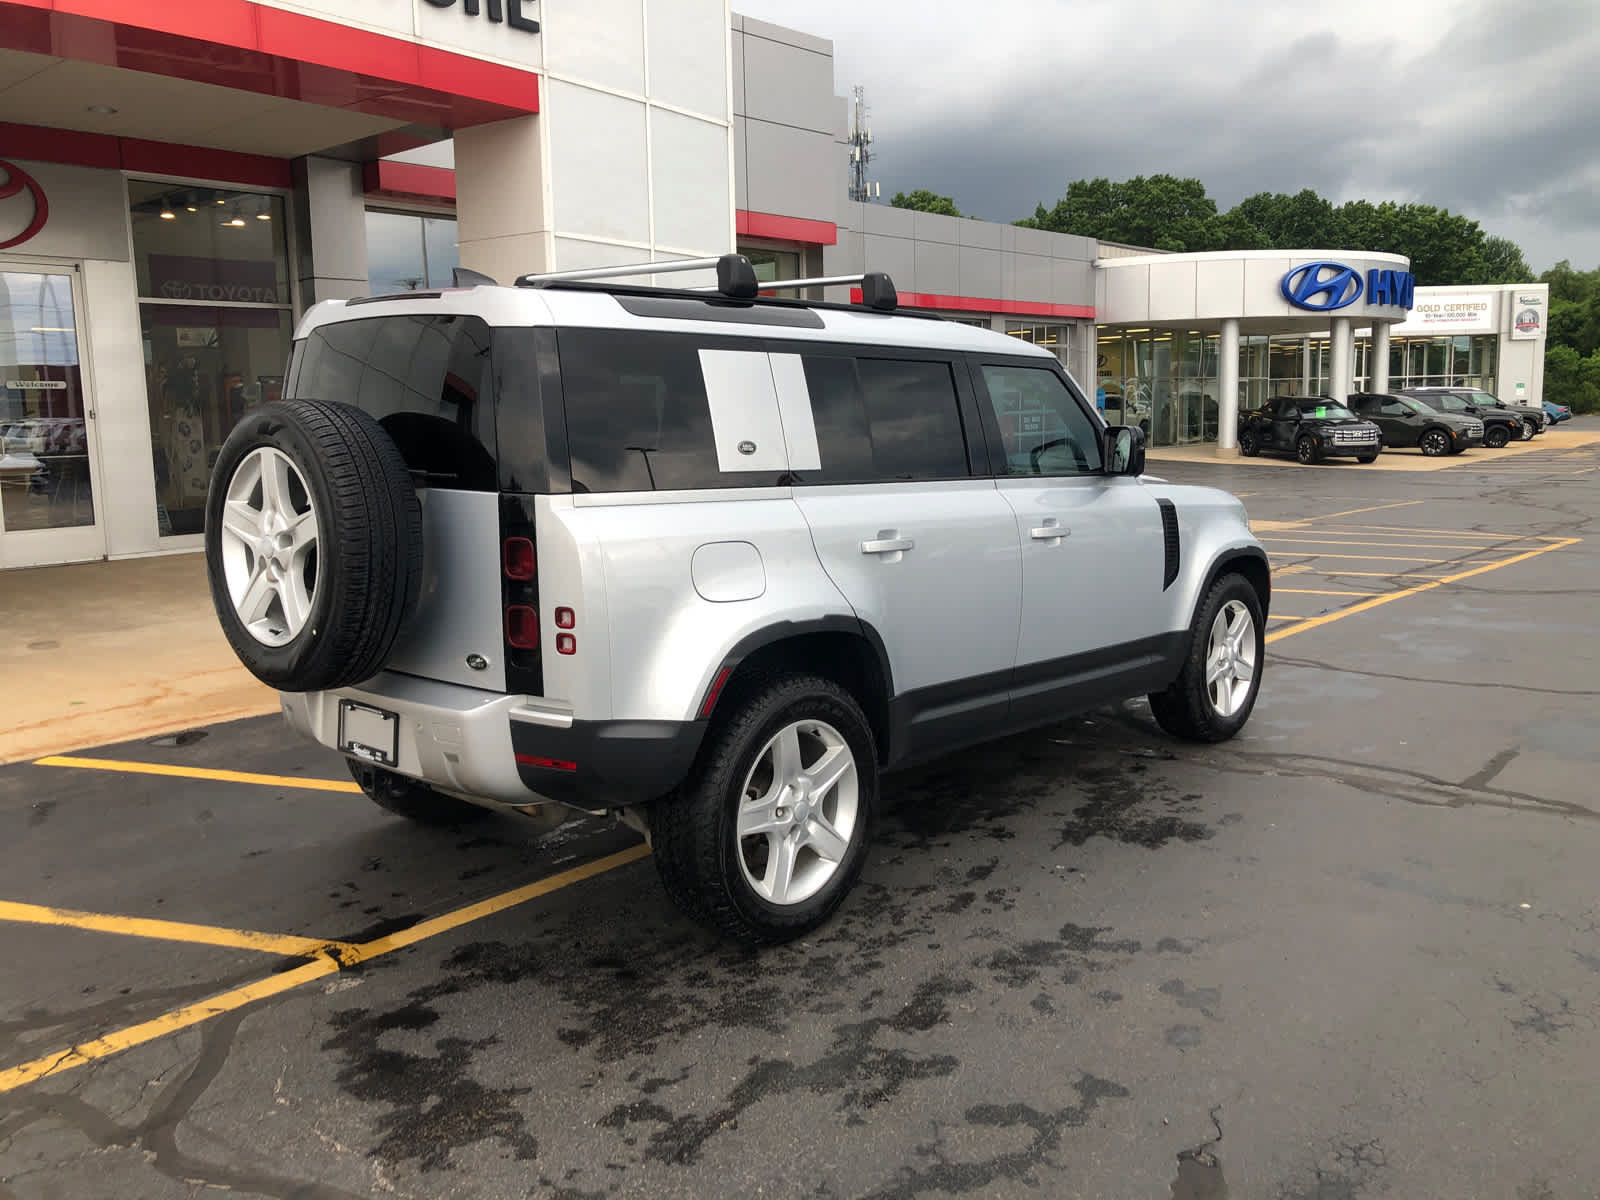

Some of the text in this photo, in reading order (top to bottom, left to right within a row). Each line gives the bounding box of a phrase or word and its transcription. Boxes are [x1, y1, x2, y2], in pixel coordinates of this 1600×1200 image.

[199, 284, 276, 302] TOYOTA
[1416, 303, 1487, 312] GOLD CERTIFIED
